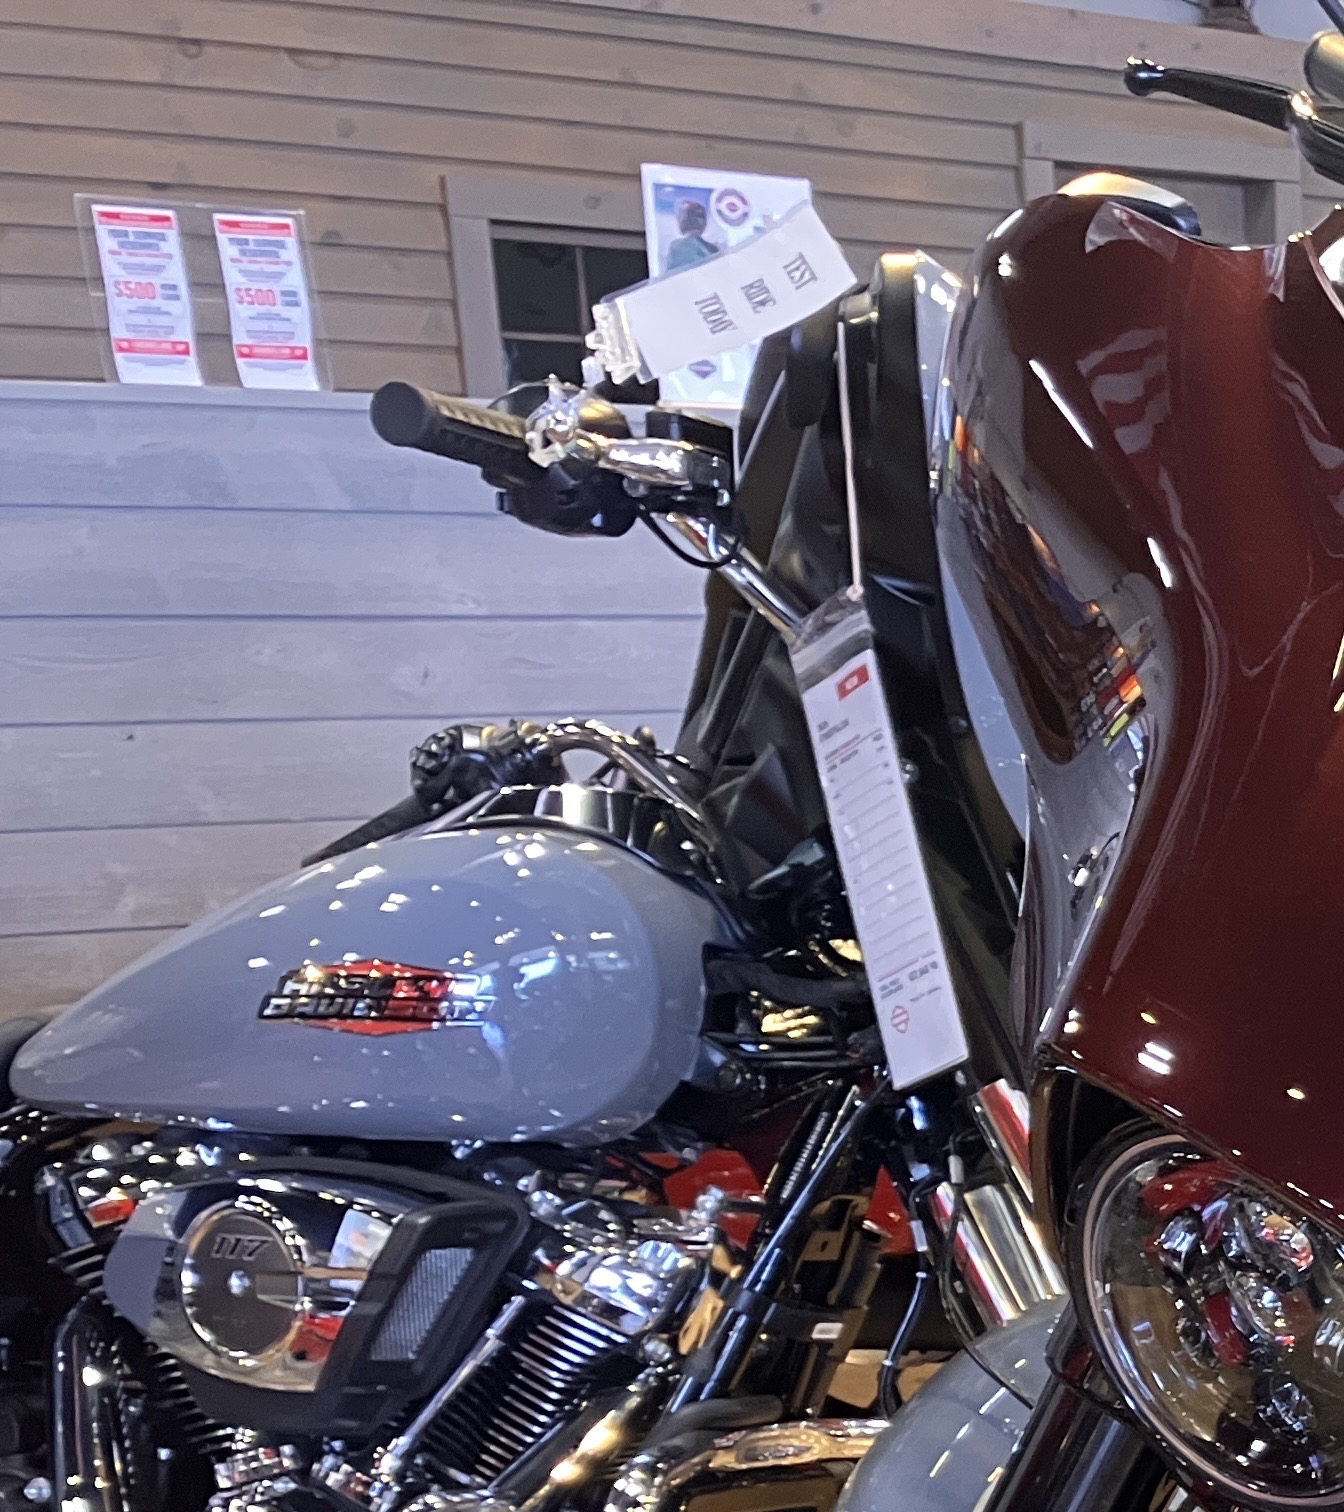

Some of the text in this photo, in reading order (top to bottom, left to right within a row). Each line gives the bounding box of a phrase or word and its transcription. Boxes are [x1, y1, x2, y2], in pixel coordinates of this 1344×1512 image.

[783, 253, 818, 290] TEST
[694, 292, 737, 335] TODAY
[741, 278, 776, 313] RIDE
[210, 1233, 275, 1261] 117
